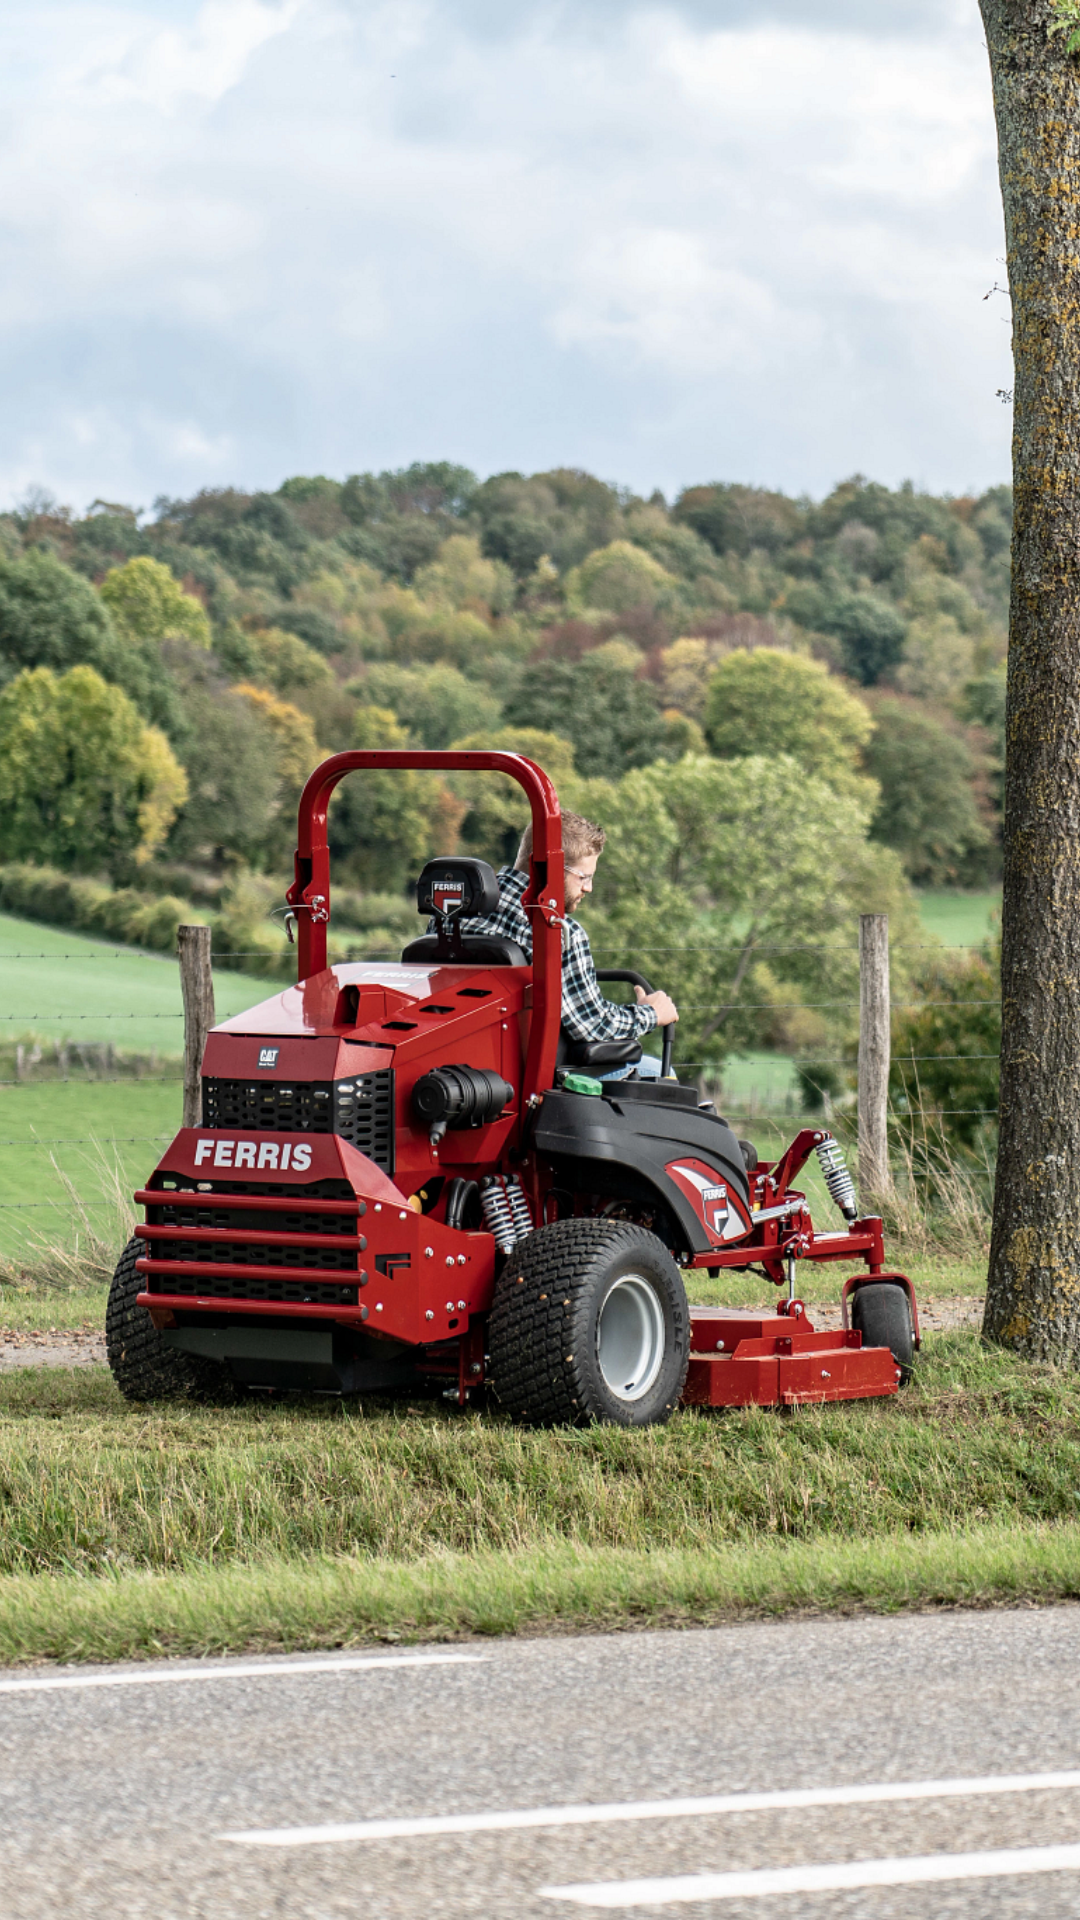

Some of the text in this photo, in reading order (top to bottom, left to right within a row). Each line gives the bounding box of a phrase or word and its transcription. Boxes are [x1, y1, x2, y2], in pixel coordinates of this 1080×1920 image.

[434, 883, 462, 892] FERRIS
[259, 1049, 279, 1062] CAT
[194, 1139, 313, 1172] FERRIS
[703, 1187, 726, 1200] FERRIS
